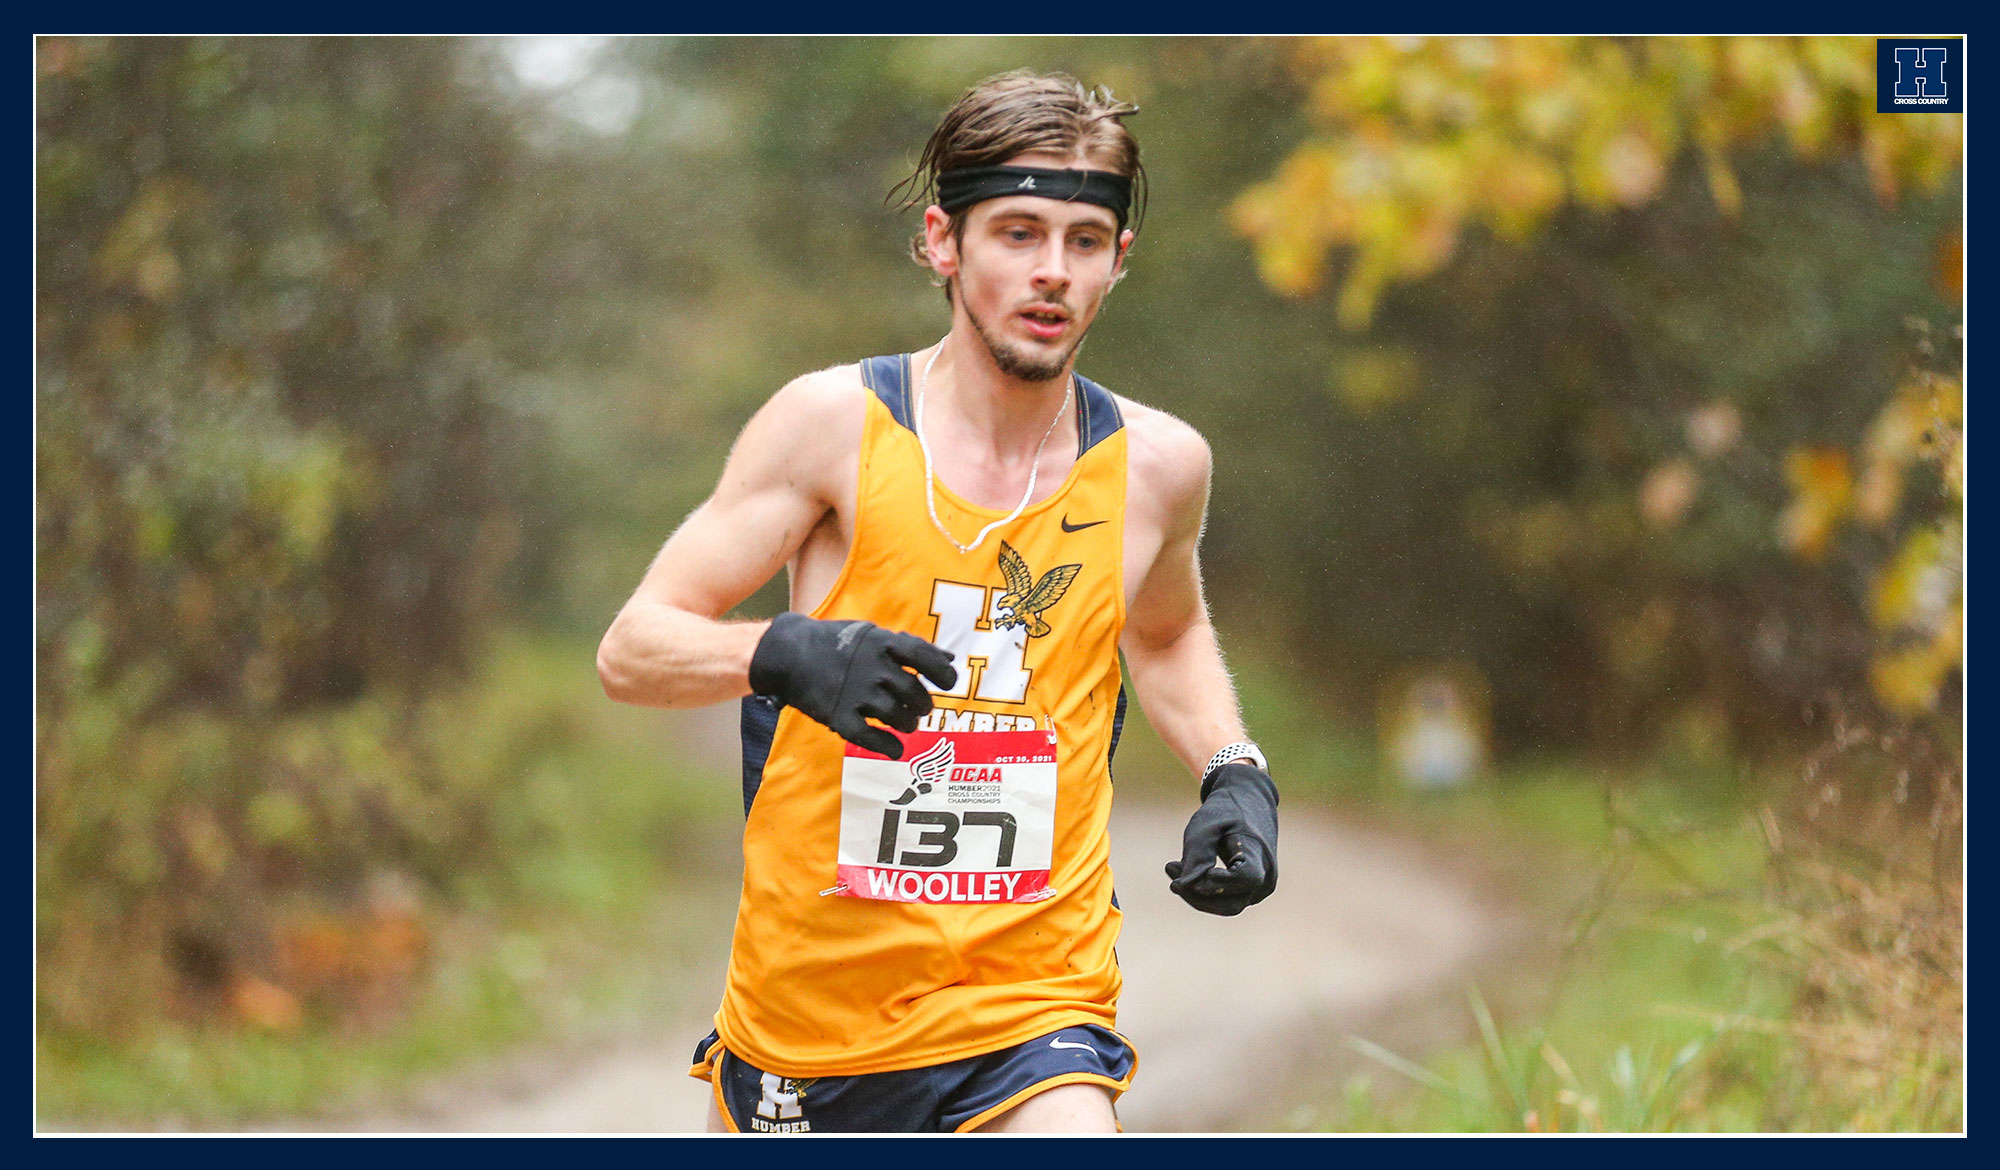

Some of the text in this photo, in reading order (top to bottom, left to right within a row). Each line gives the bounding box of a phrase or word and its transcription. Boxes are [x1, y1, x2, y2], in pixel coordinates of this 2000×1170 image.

[929, 578, 1032, 704] H
[917, 707, 1037, 732] UMBER
[949, 767, 1002, 782] OCAA
[877, 809, 1017, 867] 137
[867, 869, 1022, 901] WOOLLEY
[751, 1117, 811, 1133] HUMBER
